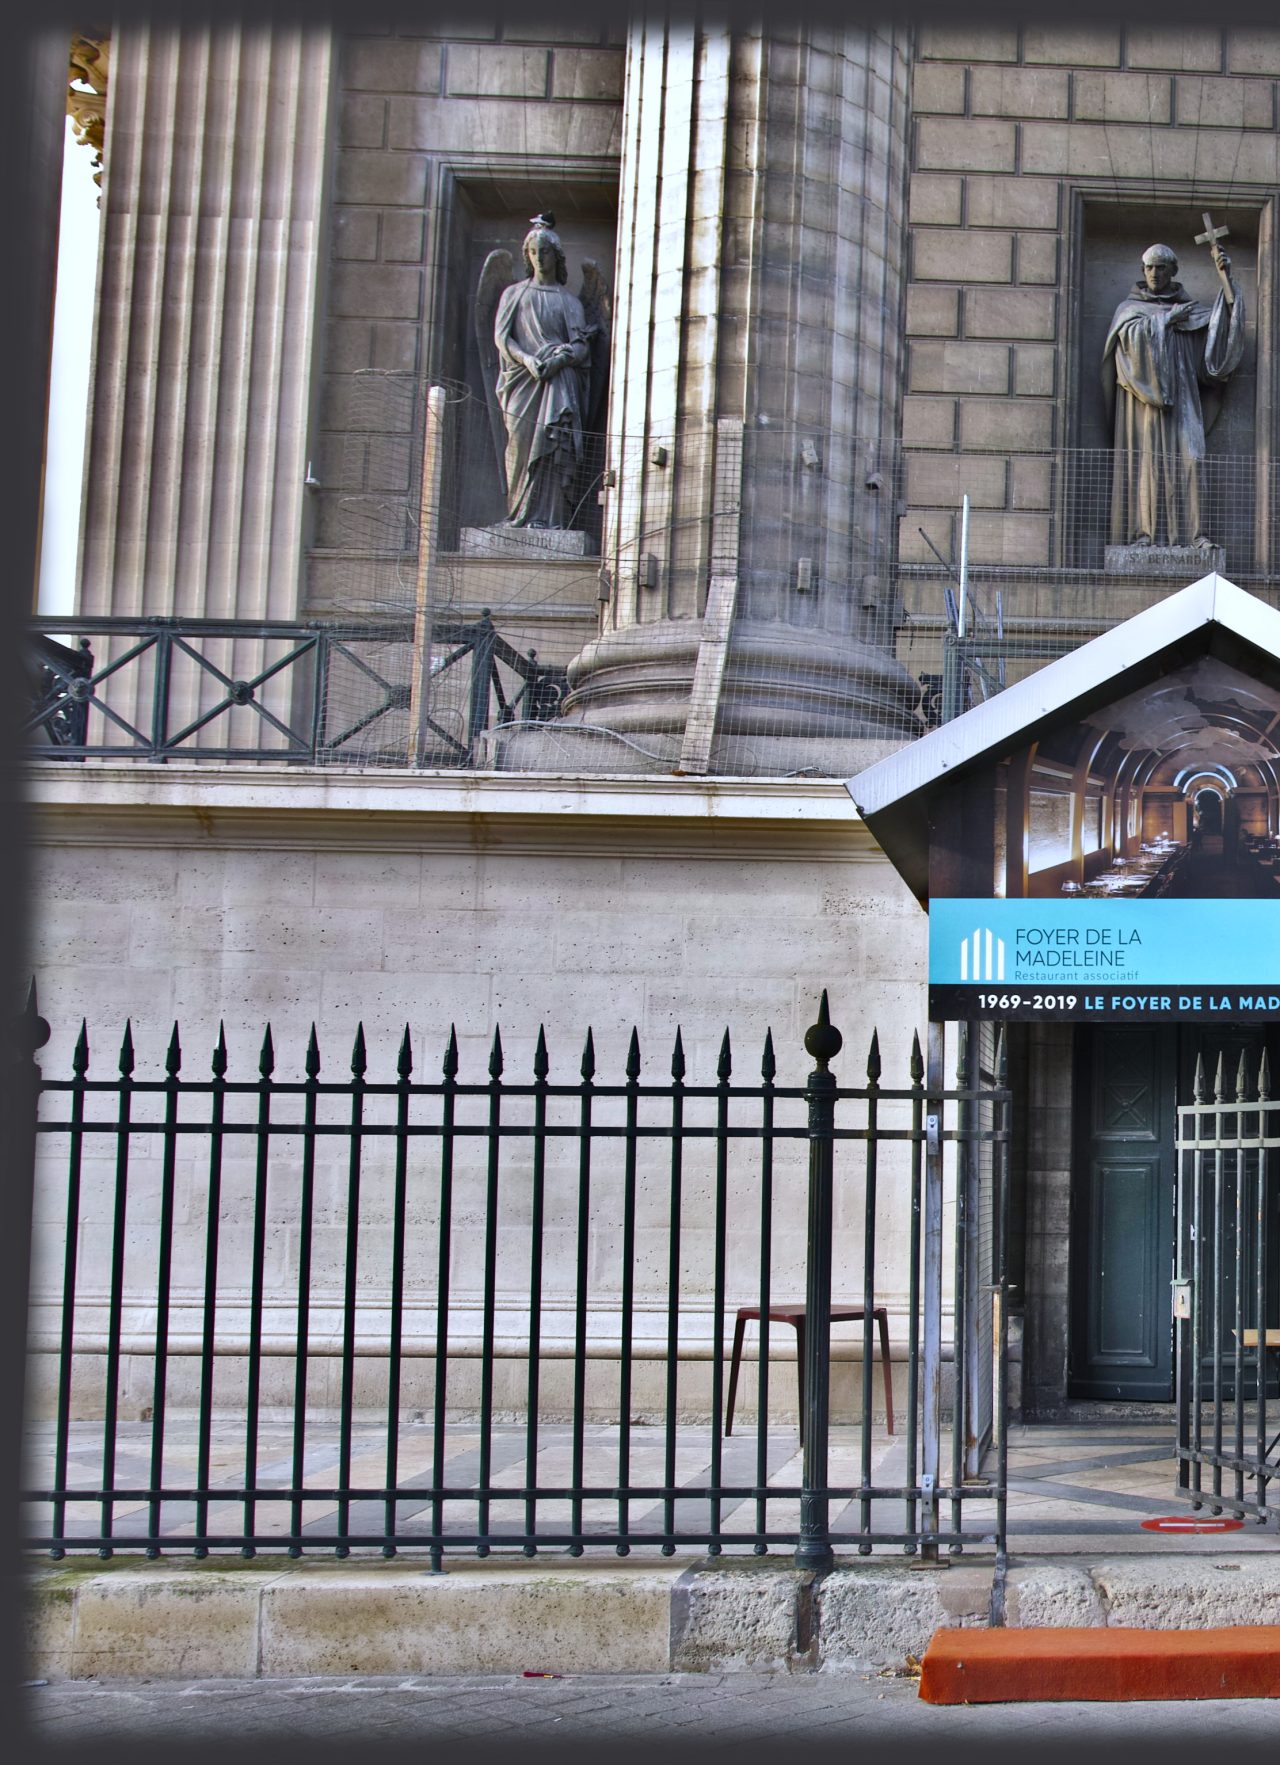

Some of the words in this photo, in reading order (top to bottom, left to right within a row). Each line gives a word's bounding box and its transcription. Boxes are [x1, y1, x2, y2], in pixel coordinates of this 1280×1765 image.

[1148, 554, 1202, 566] BERNARD
[1016, 928, 1079, 945] FOYER
[1086, 928, 1112, 945] DE
[1118, 928, 1142, 945] LA
[1016, 950, 1125, 967] MADELEINE
[1014, 970, 1078, 981] Restaurant
[1083, 970, 1140, 981] associatif
[978, 994, 1078, 1010] 1969-2019
[1084, 996, 1104, 1010] LE
[1111, 996, 1171, 1010] FOYER
[1178, 996, 1202, 1010] DE
[1209, 996, 1232, 1010] LA
